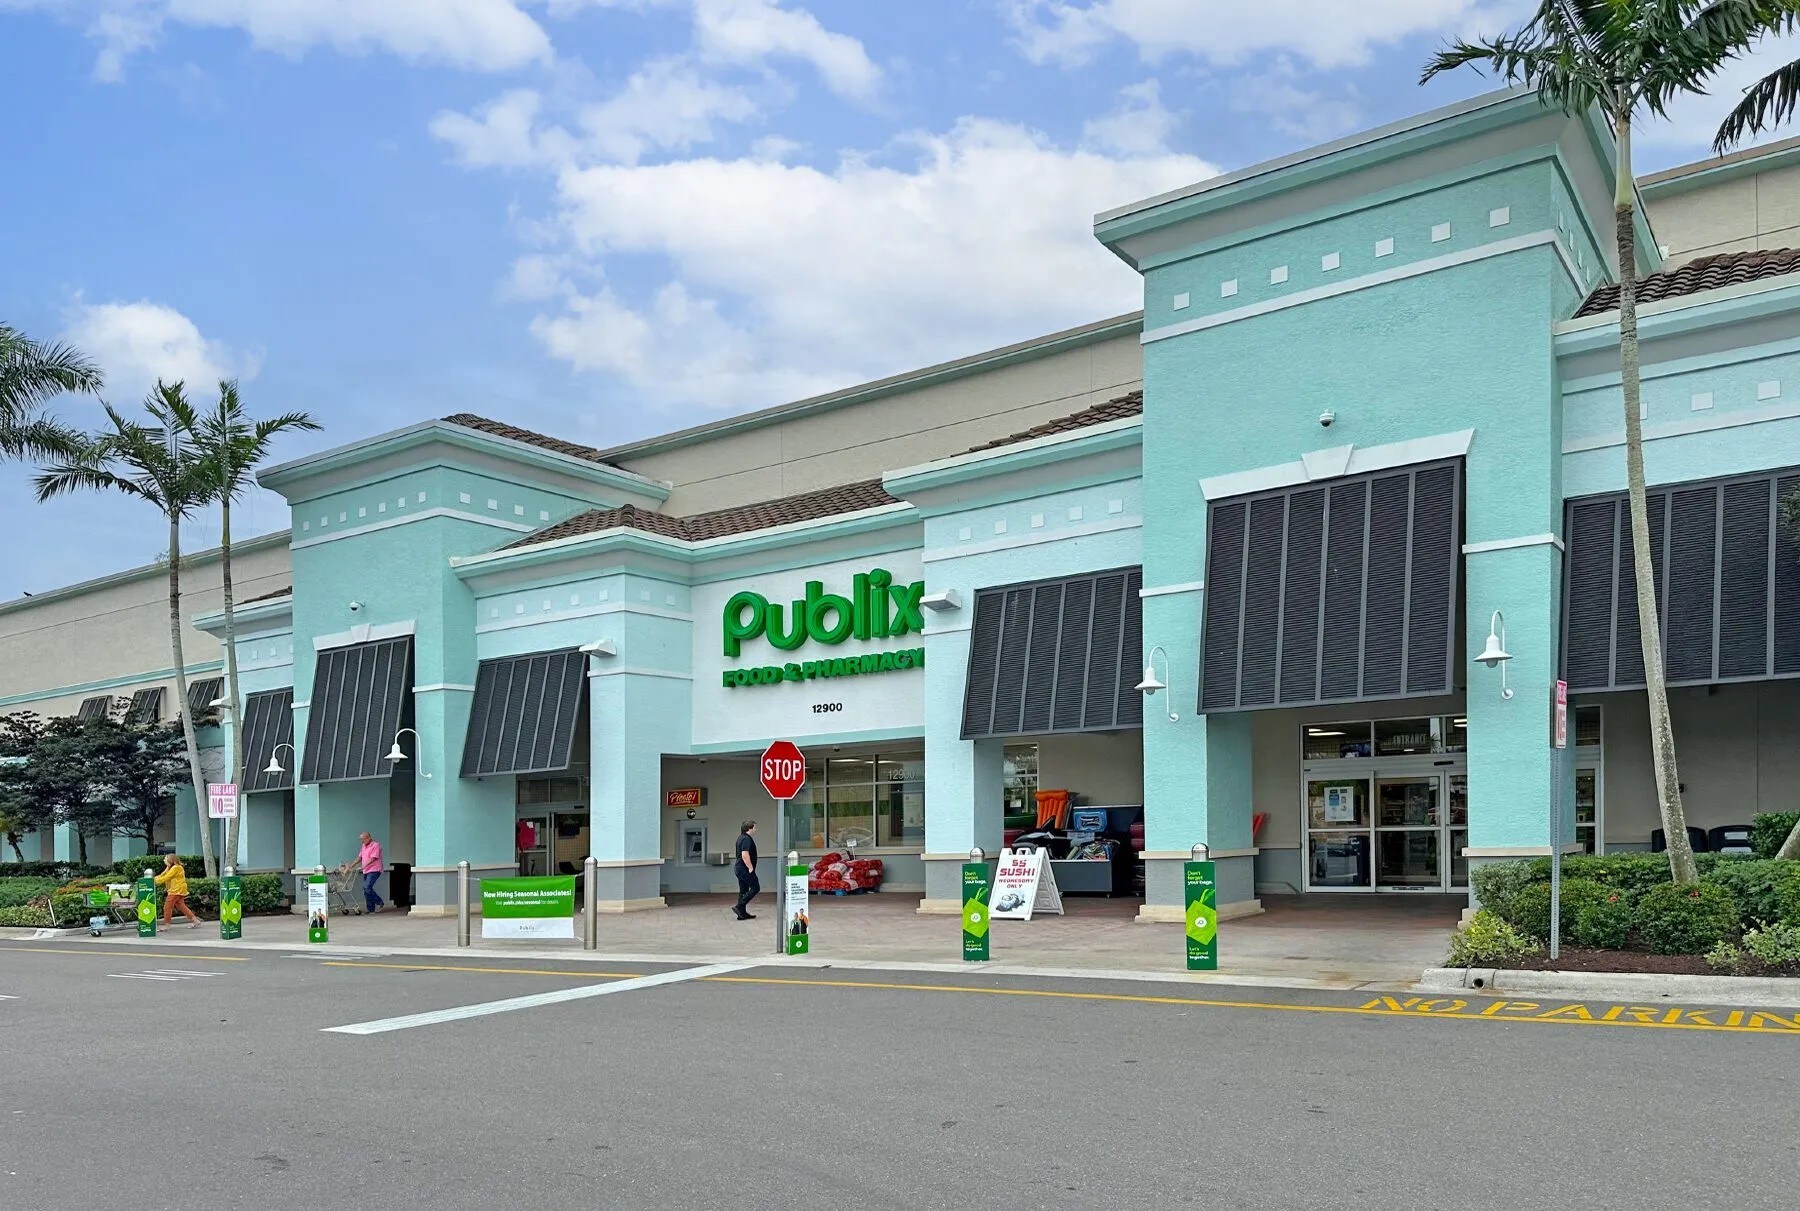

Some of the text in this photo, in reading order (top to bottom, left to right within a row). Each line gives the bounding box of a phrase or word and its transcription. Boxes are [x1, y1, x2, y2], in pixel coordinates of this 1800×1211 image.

[723, 568, 925, 657] Publix
[723, 647, 925, 687] FOOD & PHARMACY
[812, 702, 843, 713] 12900
[764, 758, 802, 781] STOP
[210, 785, 235, 796] FIRE LANE
[212, 797, 224, 814] NO
[999, 867, 1035, 876] SUSHI
[496, 890, 514, 899] Hiring
[514, 890, 539, 898] Seasonal
[540, 889, 572, 897] Associates!
[1359, 996, 1467, 1013] NO
